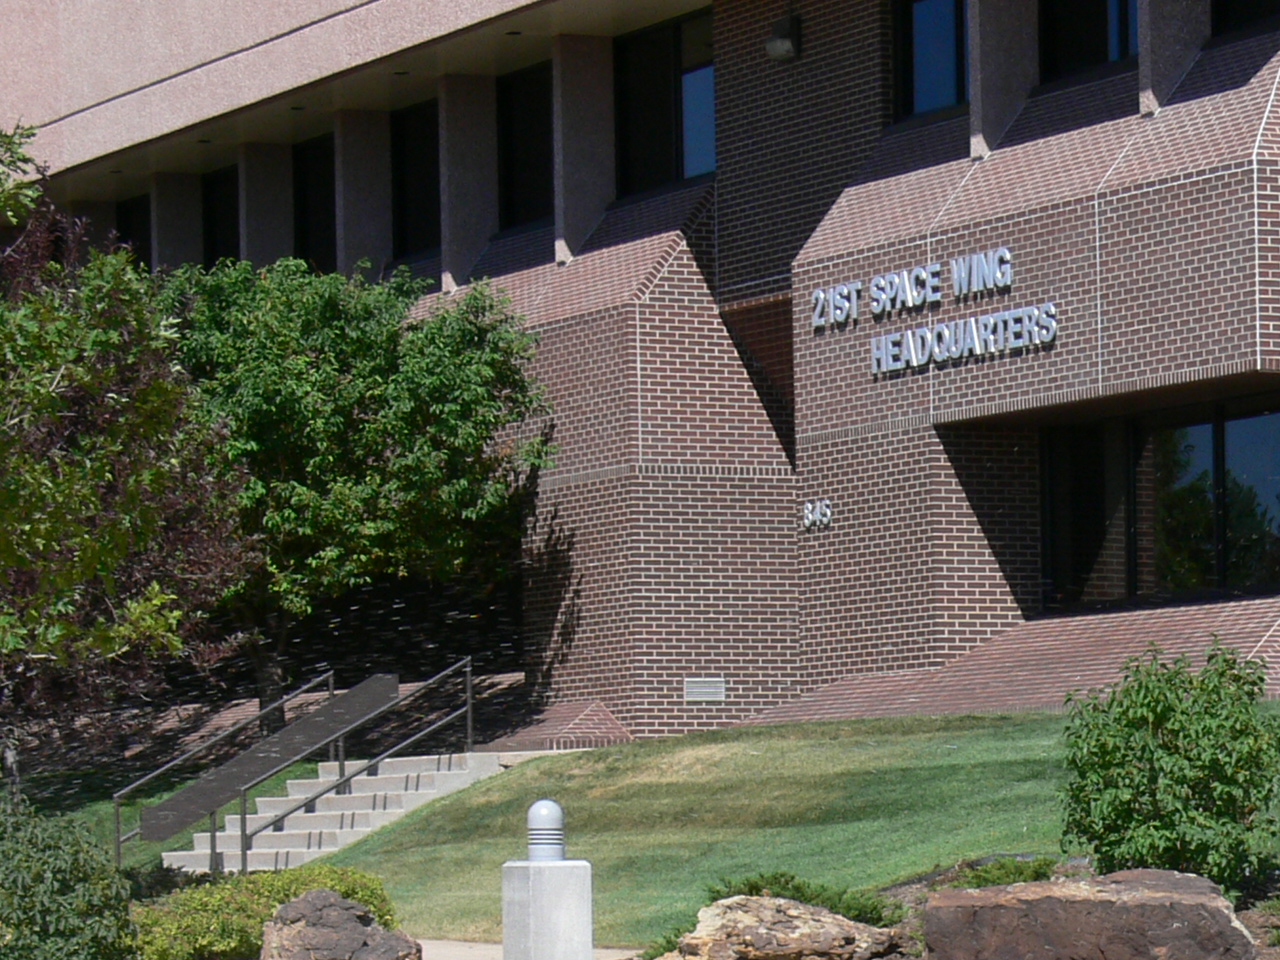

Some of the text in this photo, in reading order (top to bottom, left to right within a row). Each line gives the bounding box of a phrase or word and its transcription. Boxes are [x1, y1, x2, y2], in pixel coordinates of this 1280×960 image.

[812, 247, 1011, 326] 21ST SPACE WING
[870, 302, 1057, 373] HEADQUARTERS
[804, 500, 831, 527] 845
